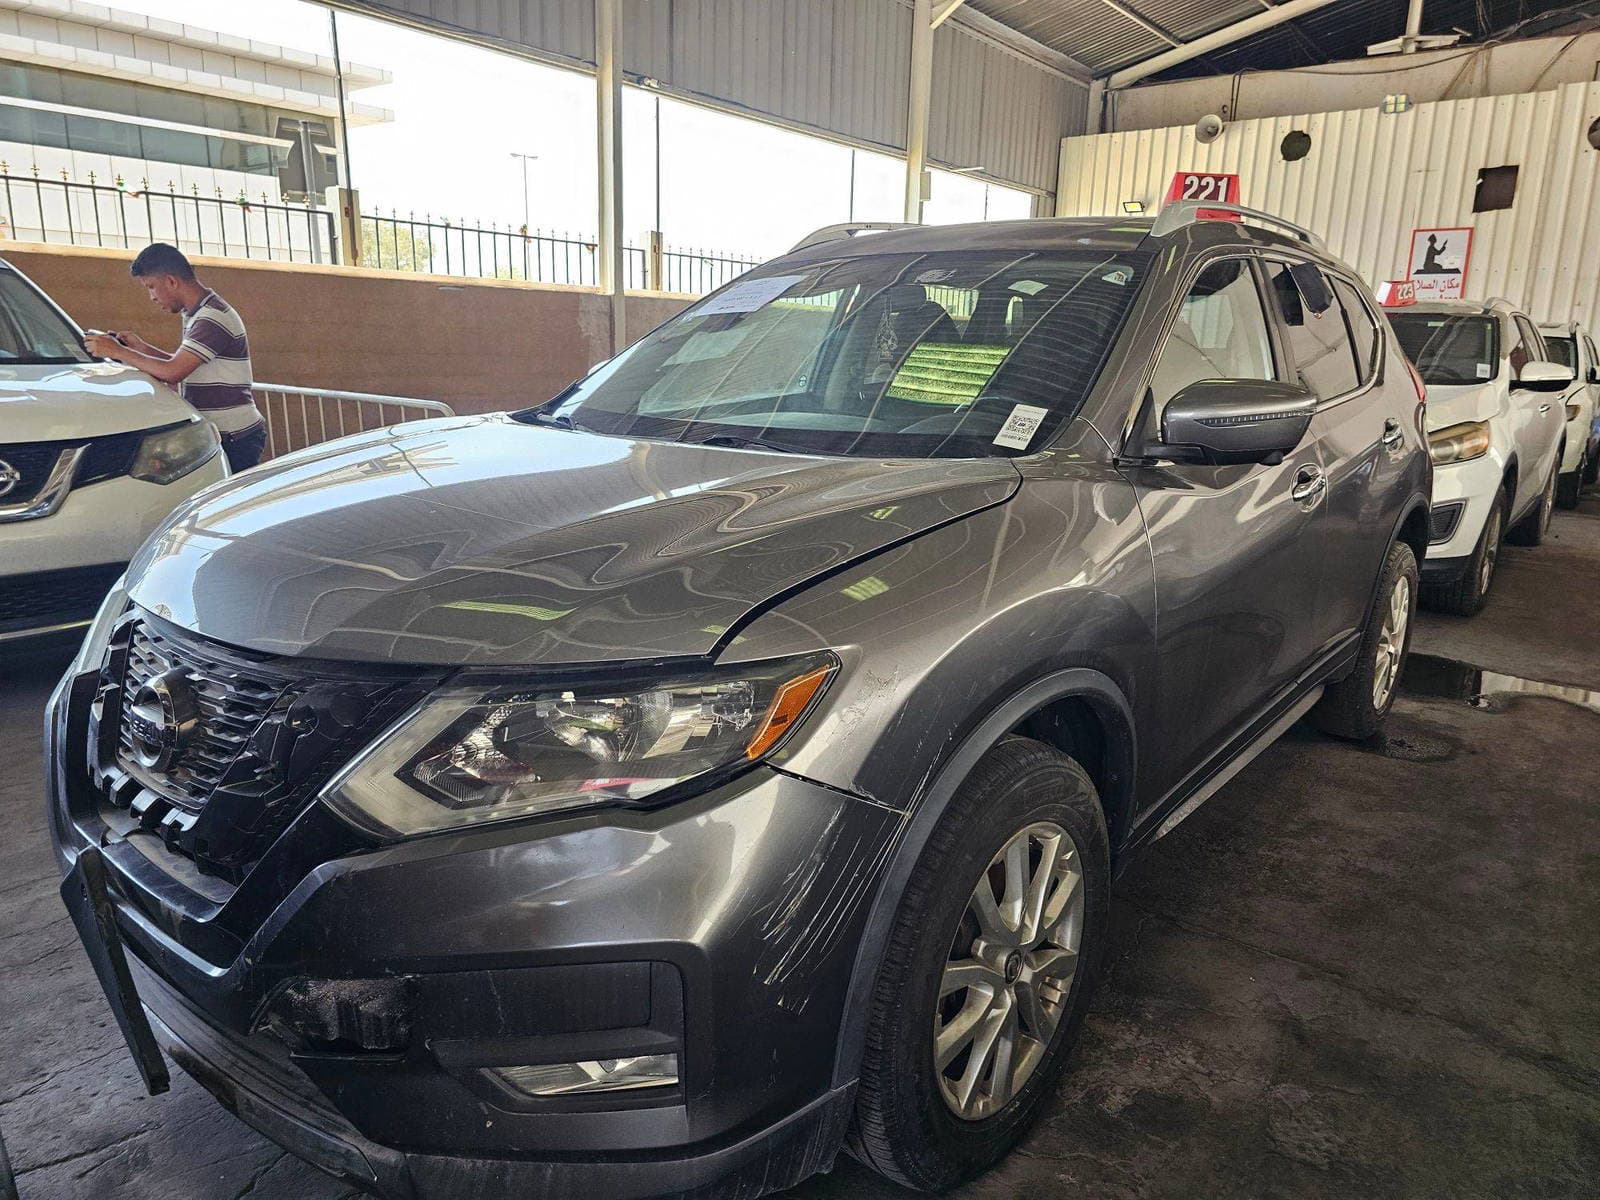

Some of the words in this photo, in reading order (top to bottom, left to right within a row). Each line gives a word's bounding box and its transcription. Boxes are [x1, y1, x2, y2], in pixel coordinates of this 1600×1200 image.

[1182, 175, 1228, 203] 221
[1397, 283, 1414, 300] 223
[1415, 279, 1438, 291] الصلا
[1439, 278, 1460, 293] مكان
